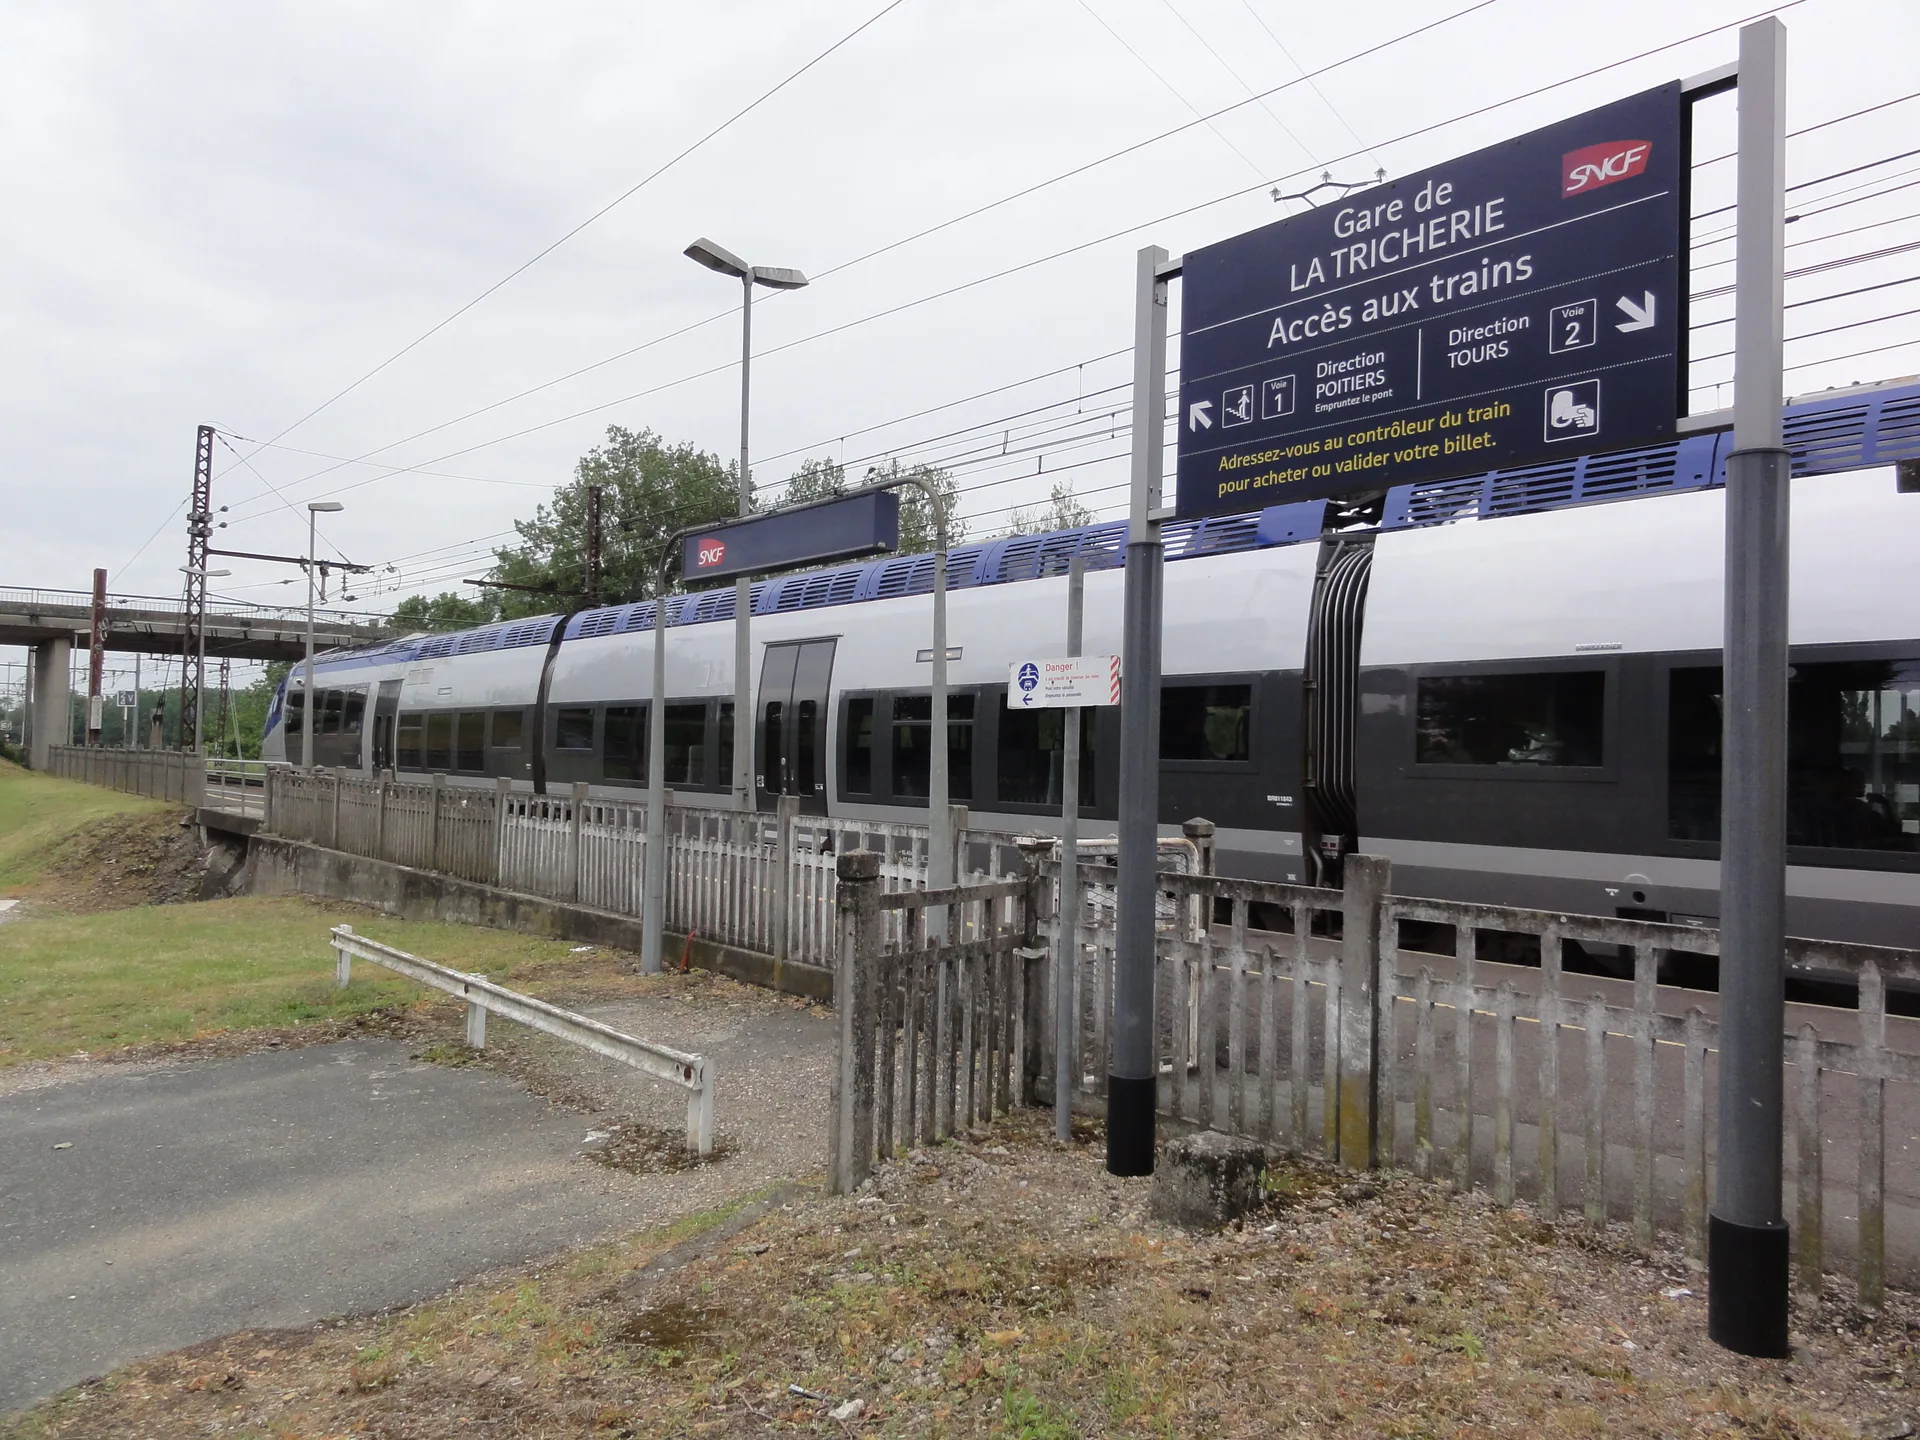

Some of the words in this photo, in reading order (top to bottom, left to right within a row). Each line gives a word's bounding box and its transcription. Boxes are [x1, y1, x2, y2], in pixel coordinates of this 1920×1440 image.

[1566, 145, 1647, 191] SNCF
[1334, 199, 1403, 239] Gare
[1415, 180, 1453, 212] de
[1291, 257, 1325, 292] LA
[1331, 198, 1505, 278] TRICHERIE
[1267, 303, 1353, 349] Accès
[1362, 287, 1420, 323] aux
[1430, 254, 1534, 304] trains
[1562, 306, 1585, 319] Voie
[1449, 316, 1530, 346] Direction
[1564, 321, 1580, 346] 2
[1317, 350, 1385, 379] Direction
[1447, 341, 1509, 369] TOURS
[1271, 380, 1287, 390] Voie
[1316, 370, 1385, 398] POITIERS
[1274, 393, 1283, 412] 1
[1315, 396, 1361, 413] Empruntez
[1362, 393, 1371, 403] le
[1372, 388, 1393, 403] pont
[1218, 441, 1320, 471] Adressez-vous
[1324, 436, 1343, 450] au
[1347, 418, 1435, 446] contrôleur
[1440, 411, 1462, 429] du
[1467, 401, 1510, 423] train
[1219, 478, 1250, 498] pour
[1254, 467, 1309, 488] acheter
[1312, 463, 1331, 478] ou
[1335, 451, 1389, 473] valider
[1393, 444, 1439, 463] votre
[1444, 431, 1496, 455] billet.
[699, 546, 724, 565] SNCF
[1045, 663, 1073, 672] Danger
